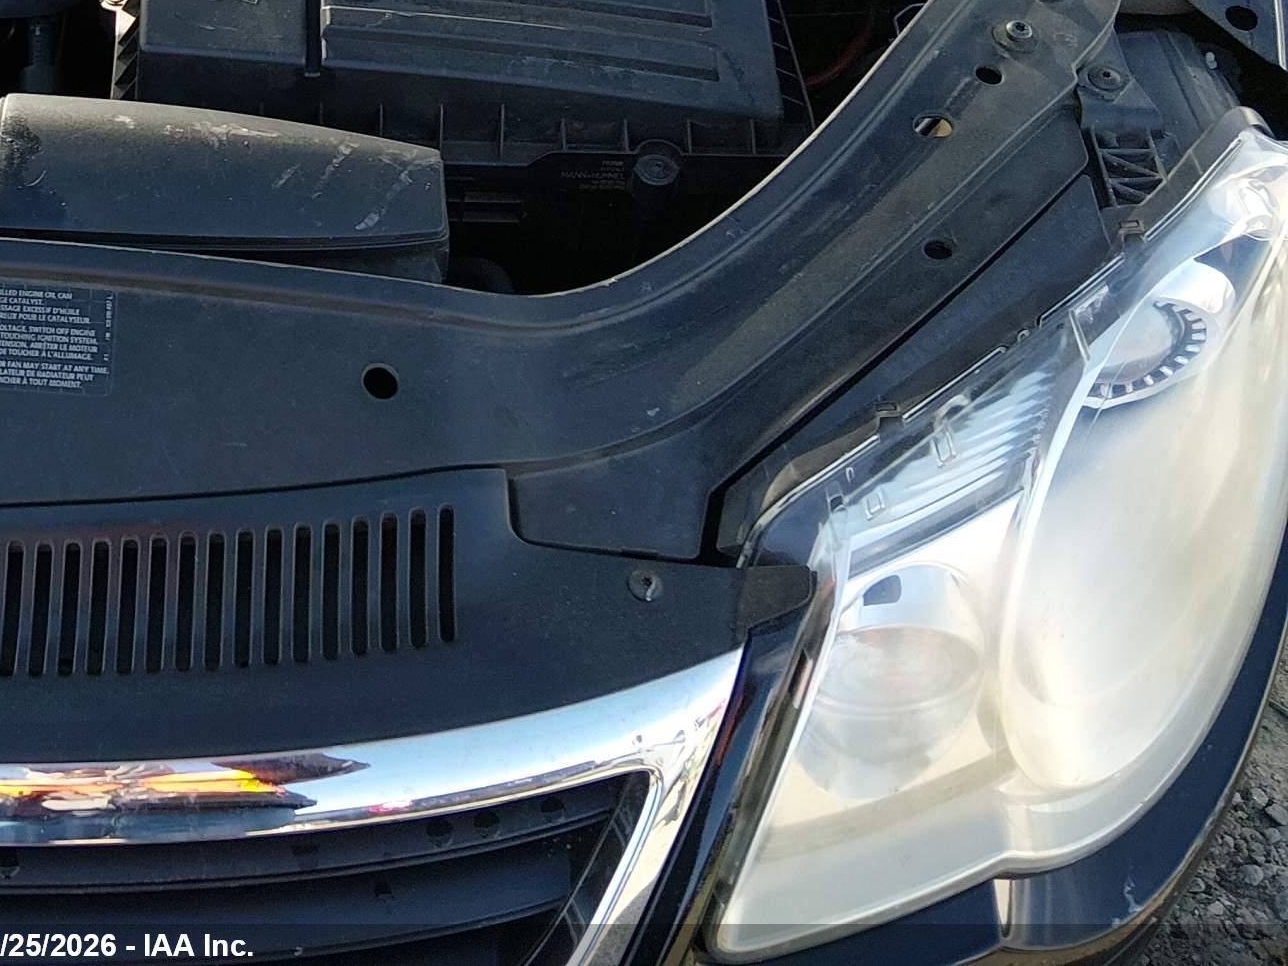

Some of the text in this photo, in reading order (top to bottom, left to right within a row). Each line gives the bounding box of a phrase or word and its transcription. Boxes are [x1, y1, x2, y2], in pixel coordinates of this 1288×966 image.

[19, 289, 43, 298] ENGINE
[44, 291, 57, 299] OIL
[57, 292, 73, 300] CAN
[9, 297, 45, 305] CATALYST.
[22, 305, 52, 314] EXCESSIF
[19, 312, 37, 321] POUR
[29, 326, 55, 334] SWITCH
[56, 327, 69, 335] OFF
[70, 328, 96, 337] ENGINE
[0, 332, 37, 341] TOUCHING
[38, 334, 69, 343] IGNITION
[8, 349, 39, 357] TOUCHER
[69, 344, 98, 353] MOTEUR
[7, 360, 21, 368] FAN
[22, 362, 40, 370] MAY
[41, 363, 62, 371] START
[63, 364, 73, 372] AT
[73, 365, 91, 373] ANY
[91, 366, 110, 375] TIME.
[36, 371, 75, 380] RADIATEUR
[76, 373, 94, 381] PEUT
[29, 378, 47, 386] TOUT
[48, 379, 82, 389] MOMENT.
